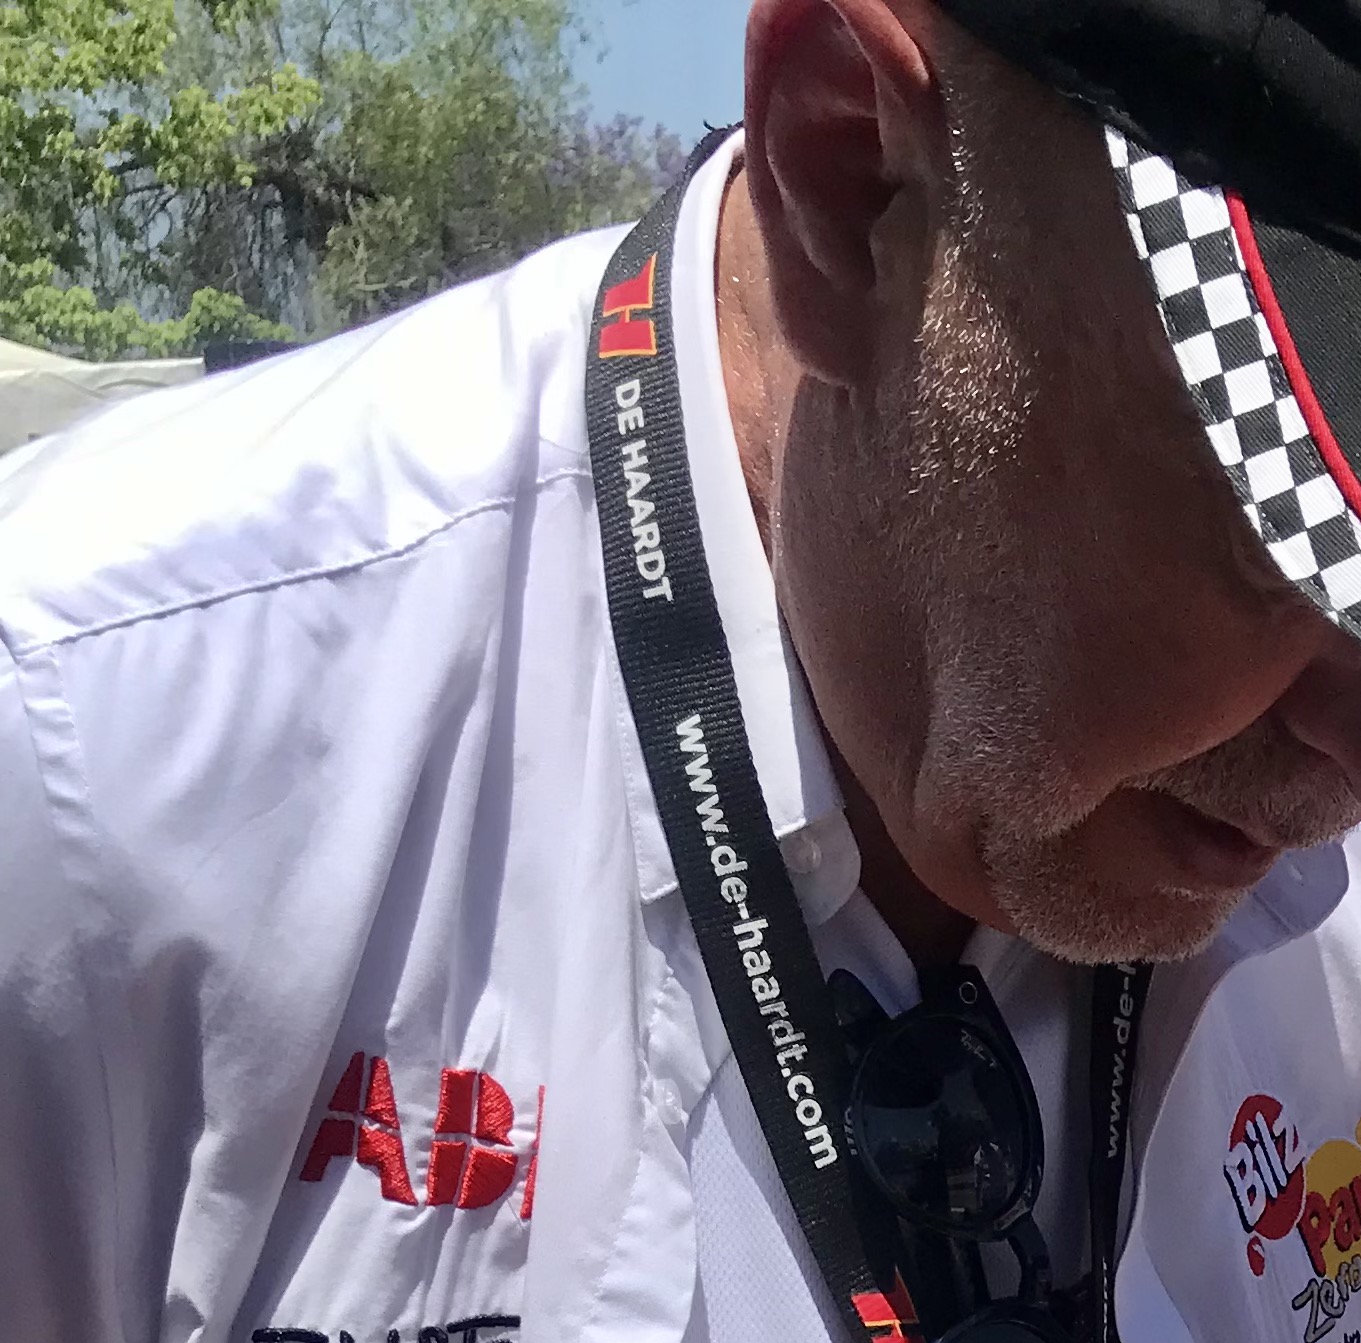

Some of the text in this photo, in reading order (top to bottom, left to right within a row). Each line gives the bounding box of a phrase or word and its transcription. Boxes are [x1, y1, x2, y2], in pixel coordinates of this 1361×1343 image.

[615, 379, 674, 604] DE HAARDT
[677, 714, 838, 1169] www.de-haardt.com
[300, 1051, 545, 1220] AB
